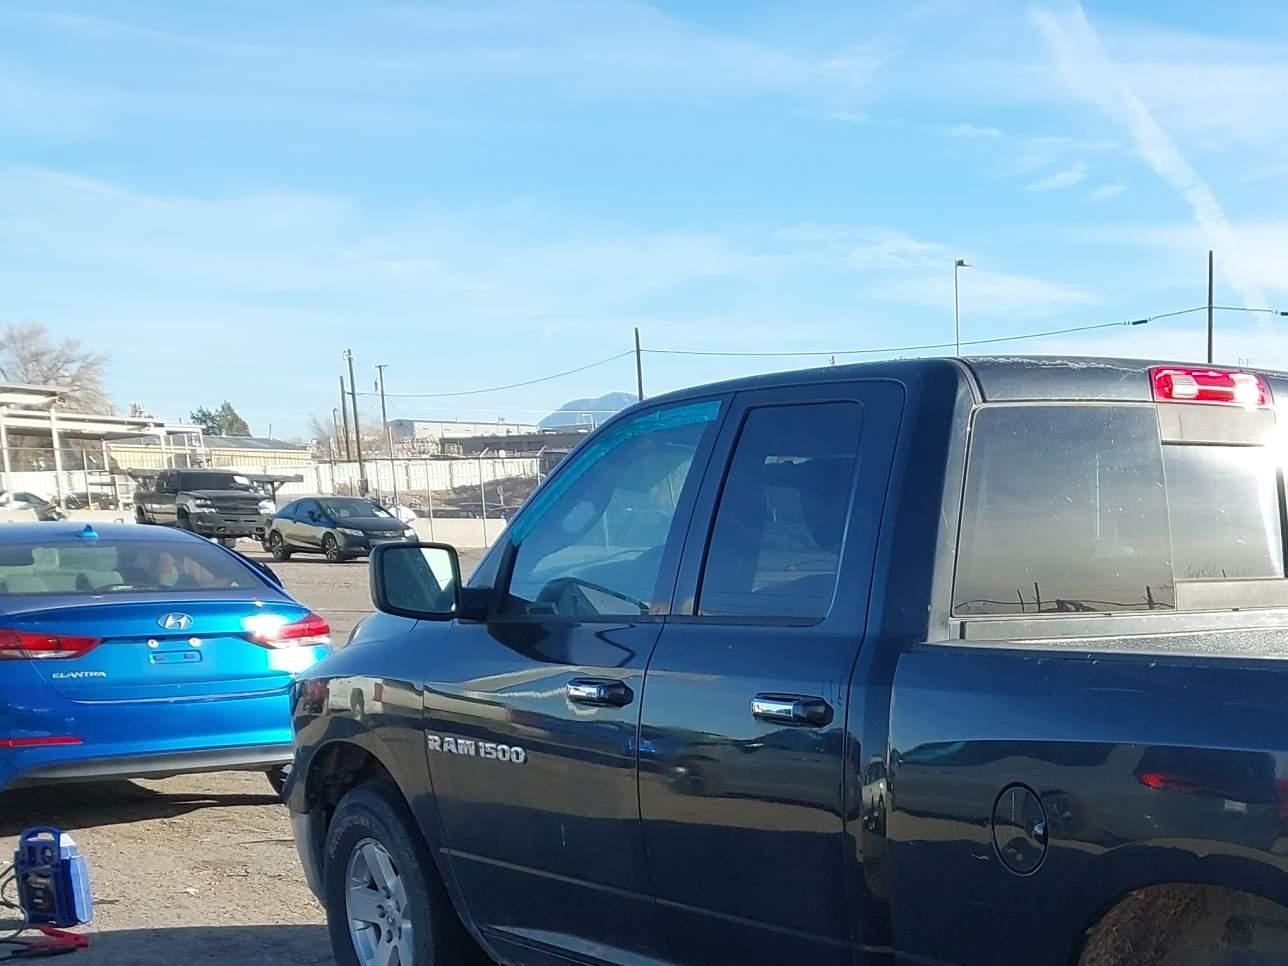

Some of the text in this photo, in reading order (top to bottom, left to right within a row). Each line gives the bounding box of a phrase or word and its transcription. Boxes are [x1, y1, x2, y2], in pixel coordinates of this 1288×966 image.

[52, 671, 107, 679] ELANTRA
[427, 734, 526, 764] RAM 1500
